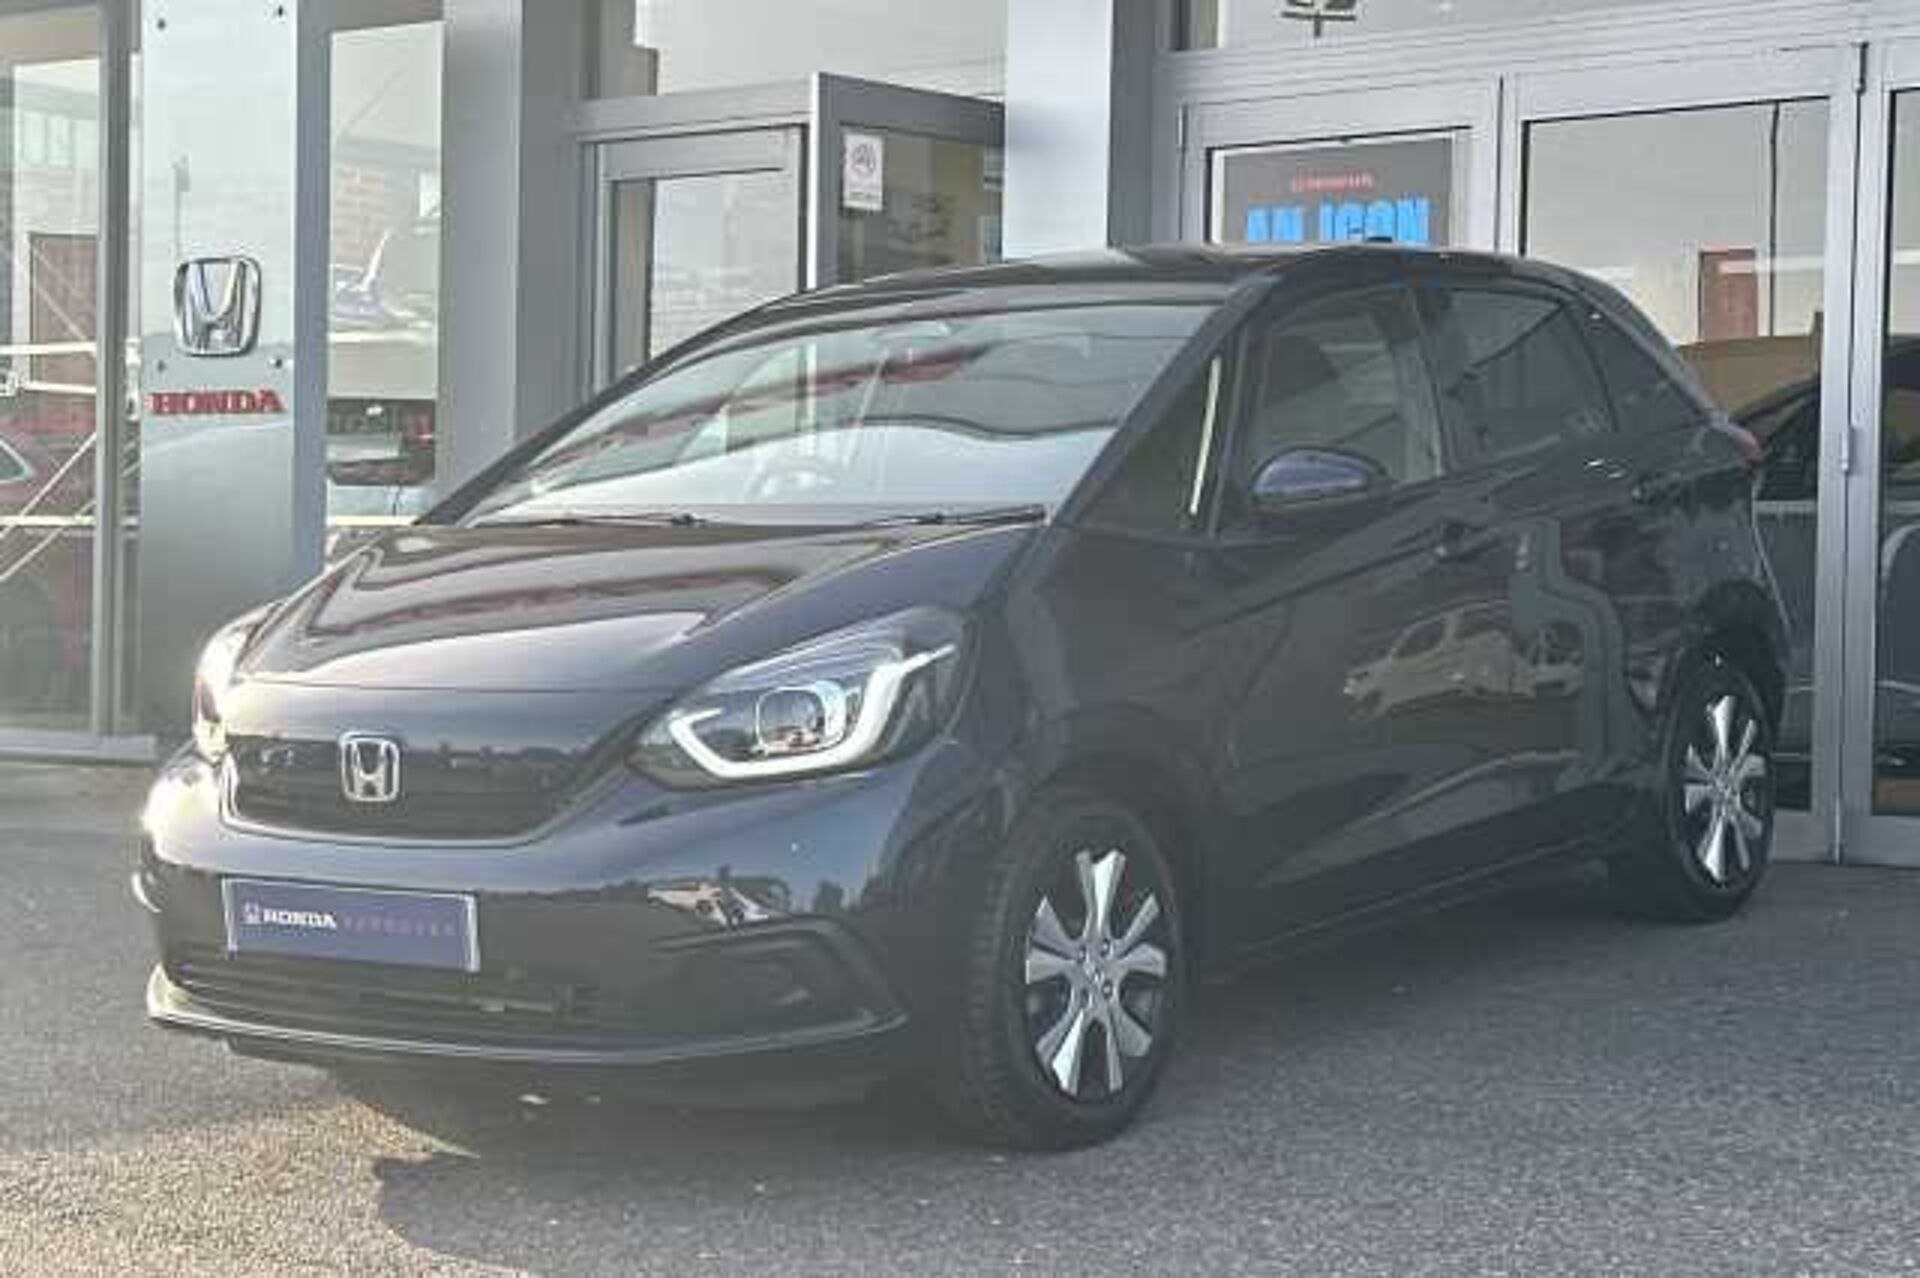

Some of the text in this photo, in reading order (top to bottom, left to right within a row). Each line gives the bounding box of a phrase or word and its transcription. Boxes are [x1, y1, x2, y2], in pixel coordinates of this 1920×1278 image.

[1319, 197, 1430, 243] ICON
[146, 388, 284, 415] HONDA
[262, 907, 337, 929] HONDA
